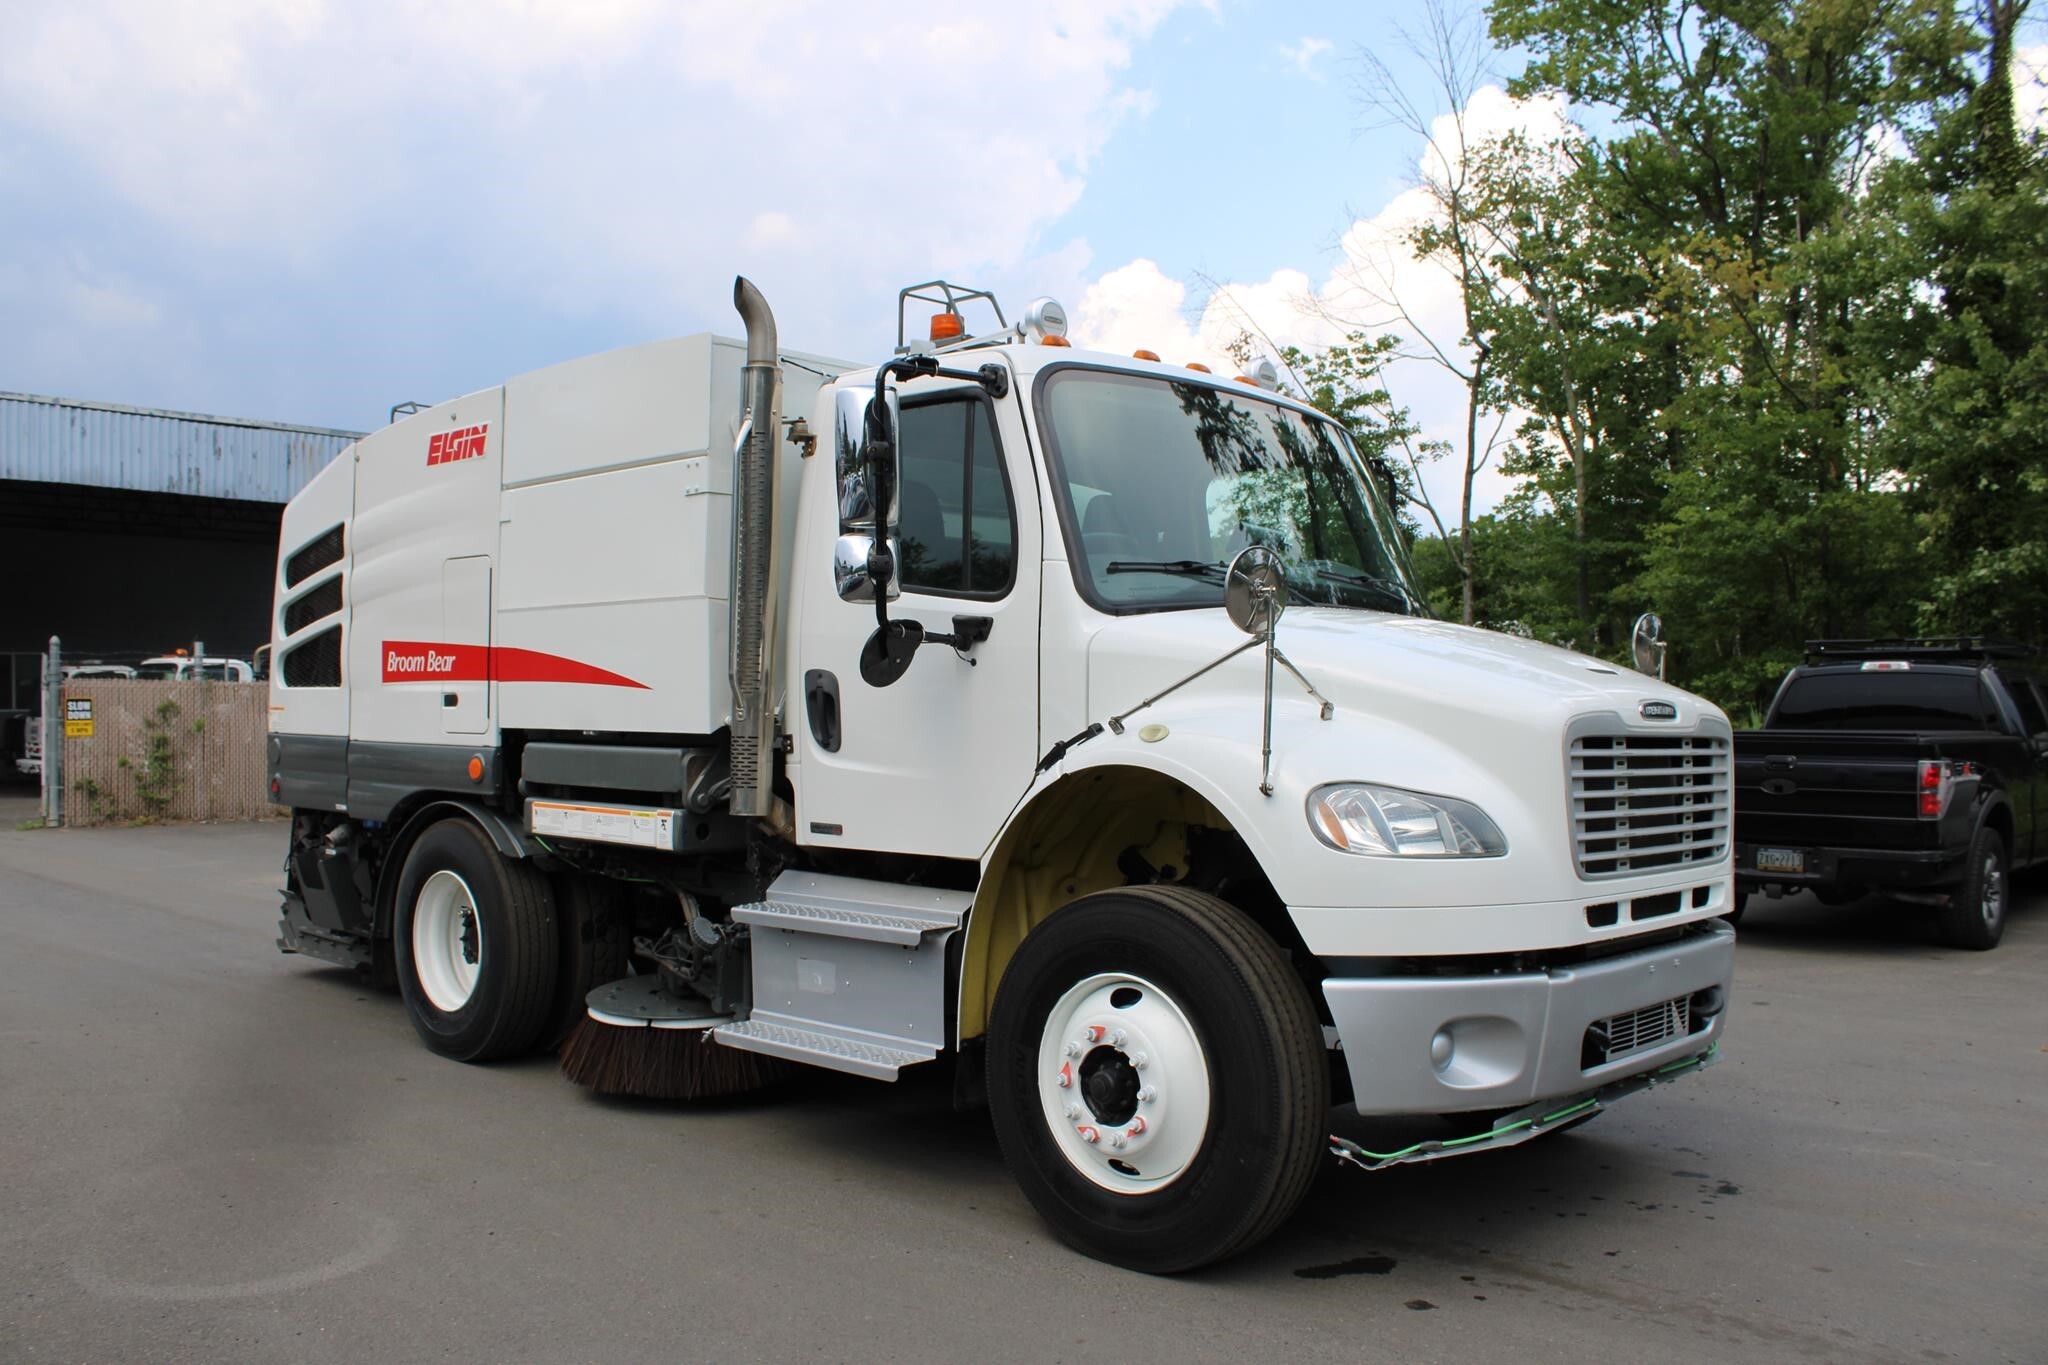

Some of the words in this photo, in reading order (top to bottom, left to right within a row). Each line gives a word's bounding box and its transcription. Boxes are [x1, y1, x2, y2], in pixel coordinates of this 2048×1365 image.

[427, 423, 488, 466] ELGIN
[387, 650, 425, 672] Broom
[426, 650, 456, 672] Bear
[67, 701, 91, 710] SLOW
[67, 711, 92, 720] DOWN
